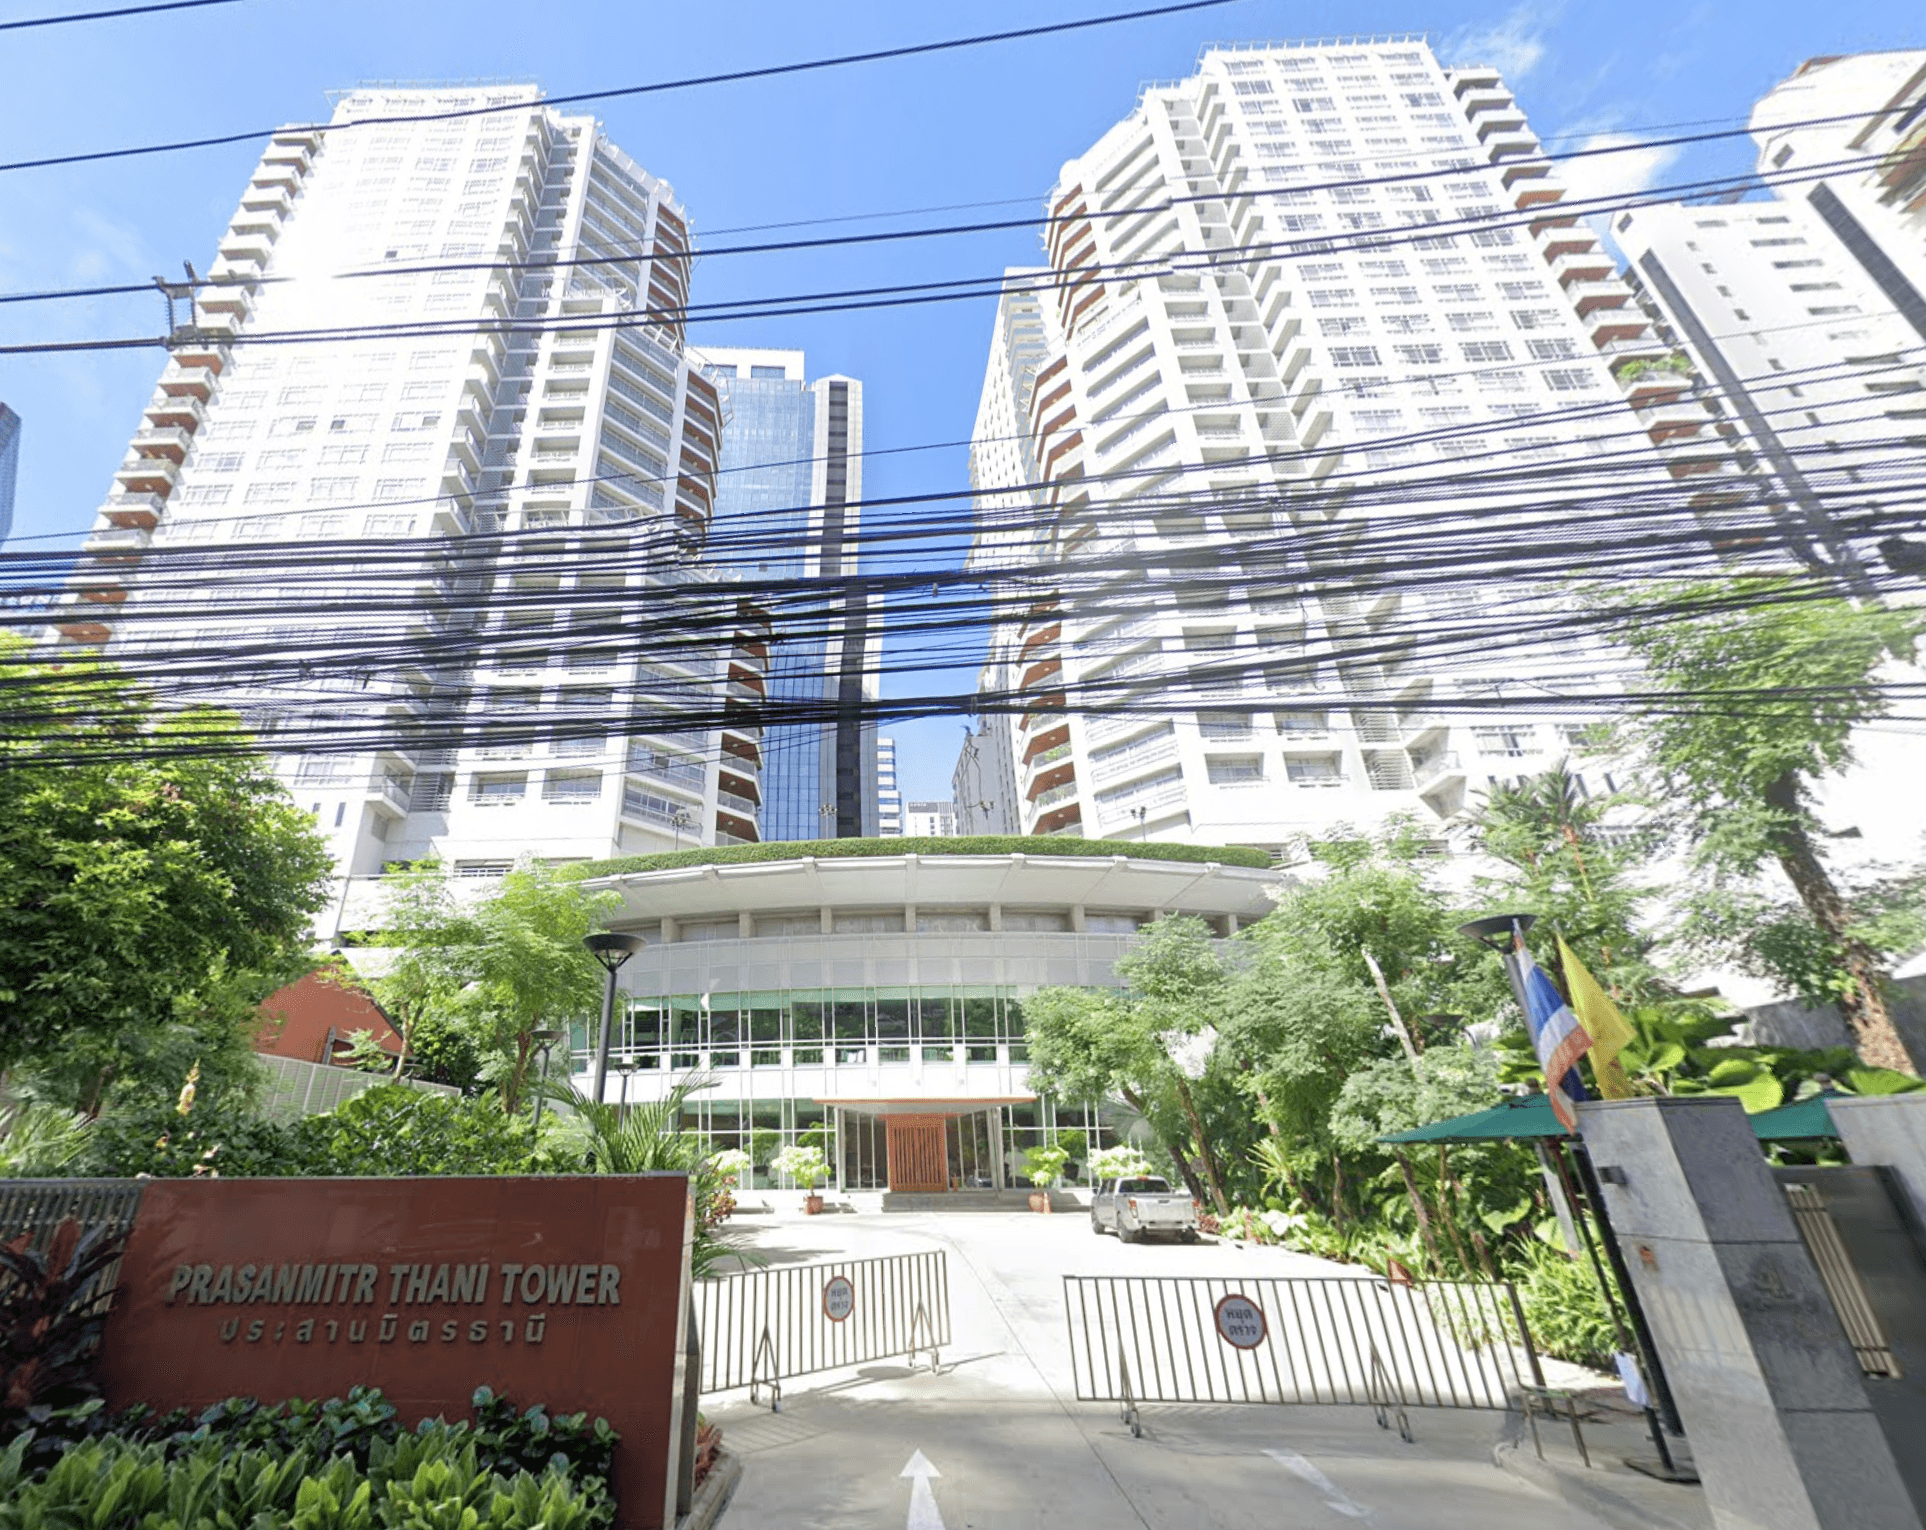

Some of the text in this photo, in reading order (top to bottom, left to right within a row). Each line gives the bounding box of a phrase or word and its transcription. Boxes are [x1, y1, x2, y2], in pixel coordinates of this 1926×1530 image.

[167, 1263, 621, 1304] PRASANMITR THANI TOWER
[219, 1313, 547, 1342] ประสานมิตรธานี
